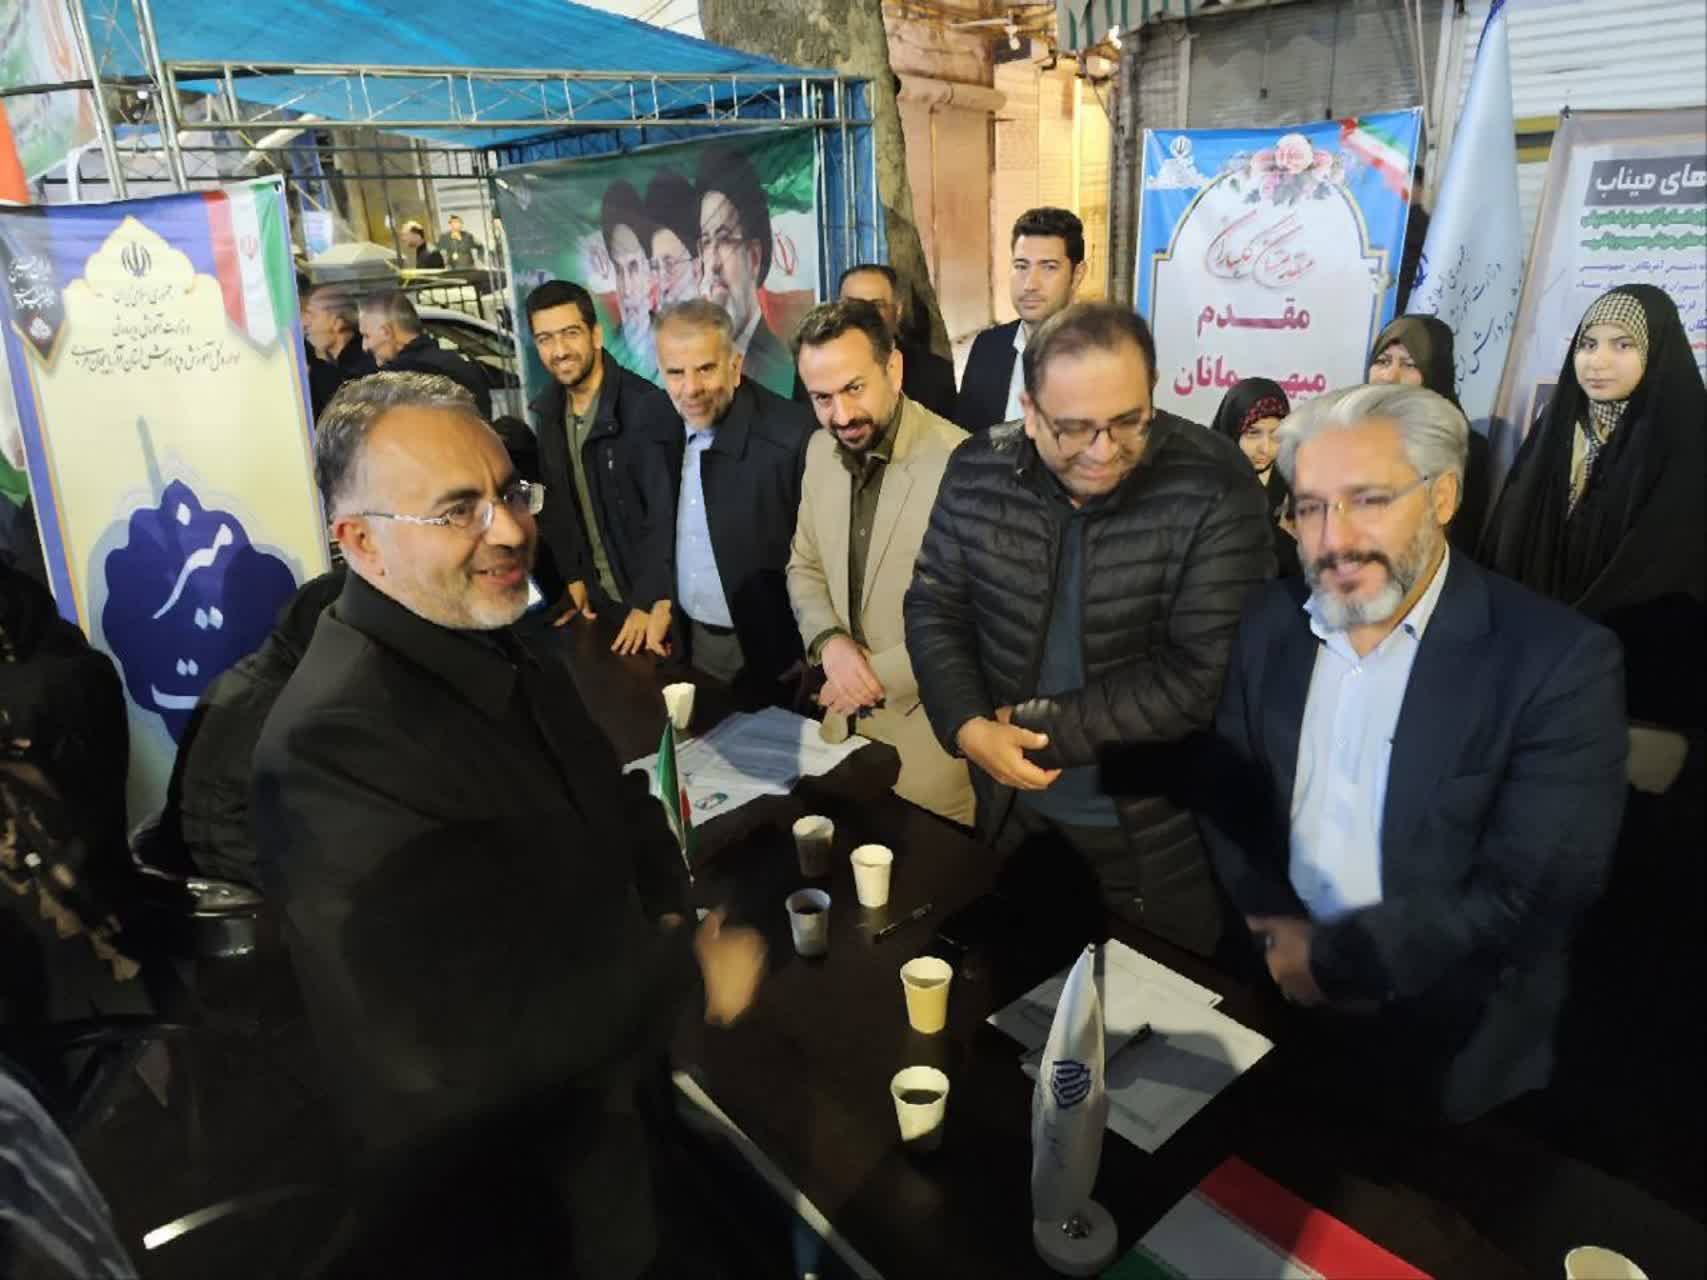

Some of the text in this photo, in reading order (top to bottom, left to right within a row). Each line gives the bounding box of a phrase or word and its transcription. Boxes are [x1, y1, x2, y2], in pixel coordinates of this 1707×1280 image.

[1596, 166, 1657, 199] میناب
[1197, 297, 1311, 336] مقدم
[1173, 354, 1327, 398] میهمانان
[152, 502, 234, 630] میز
